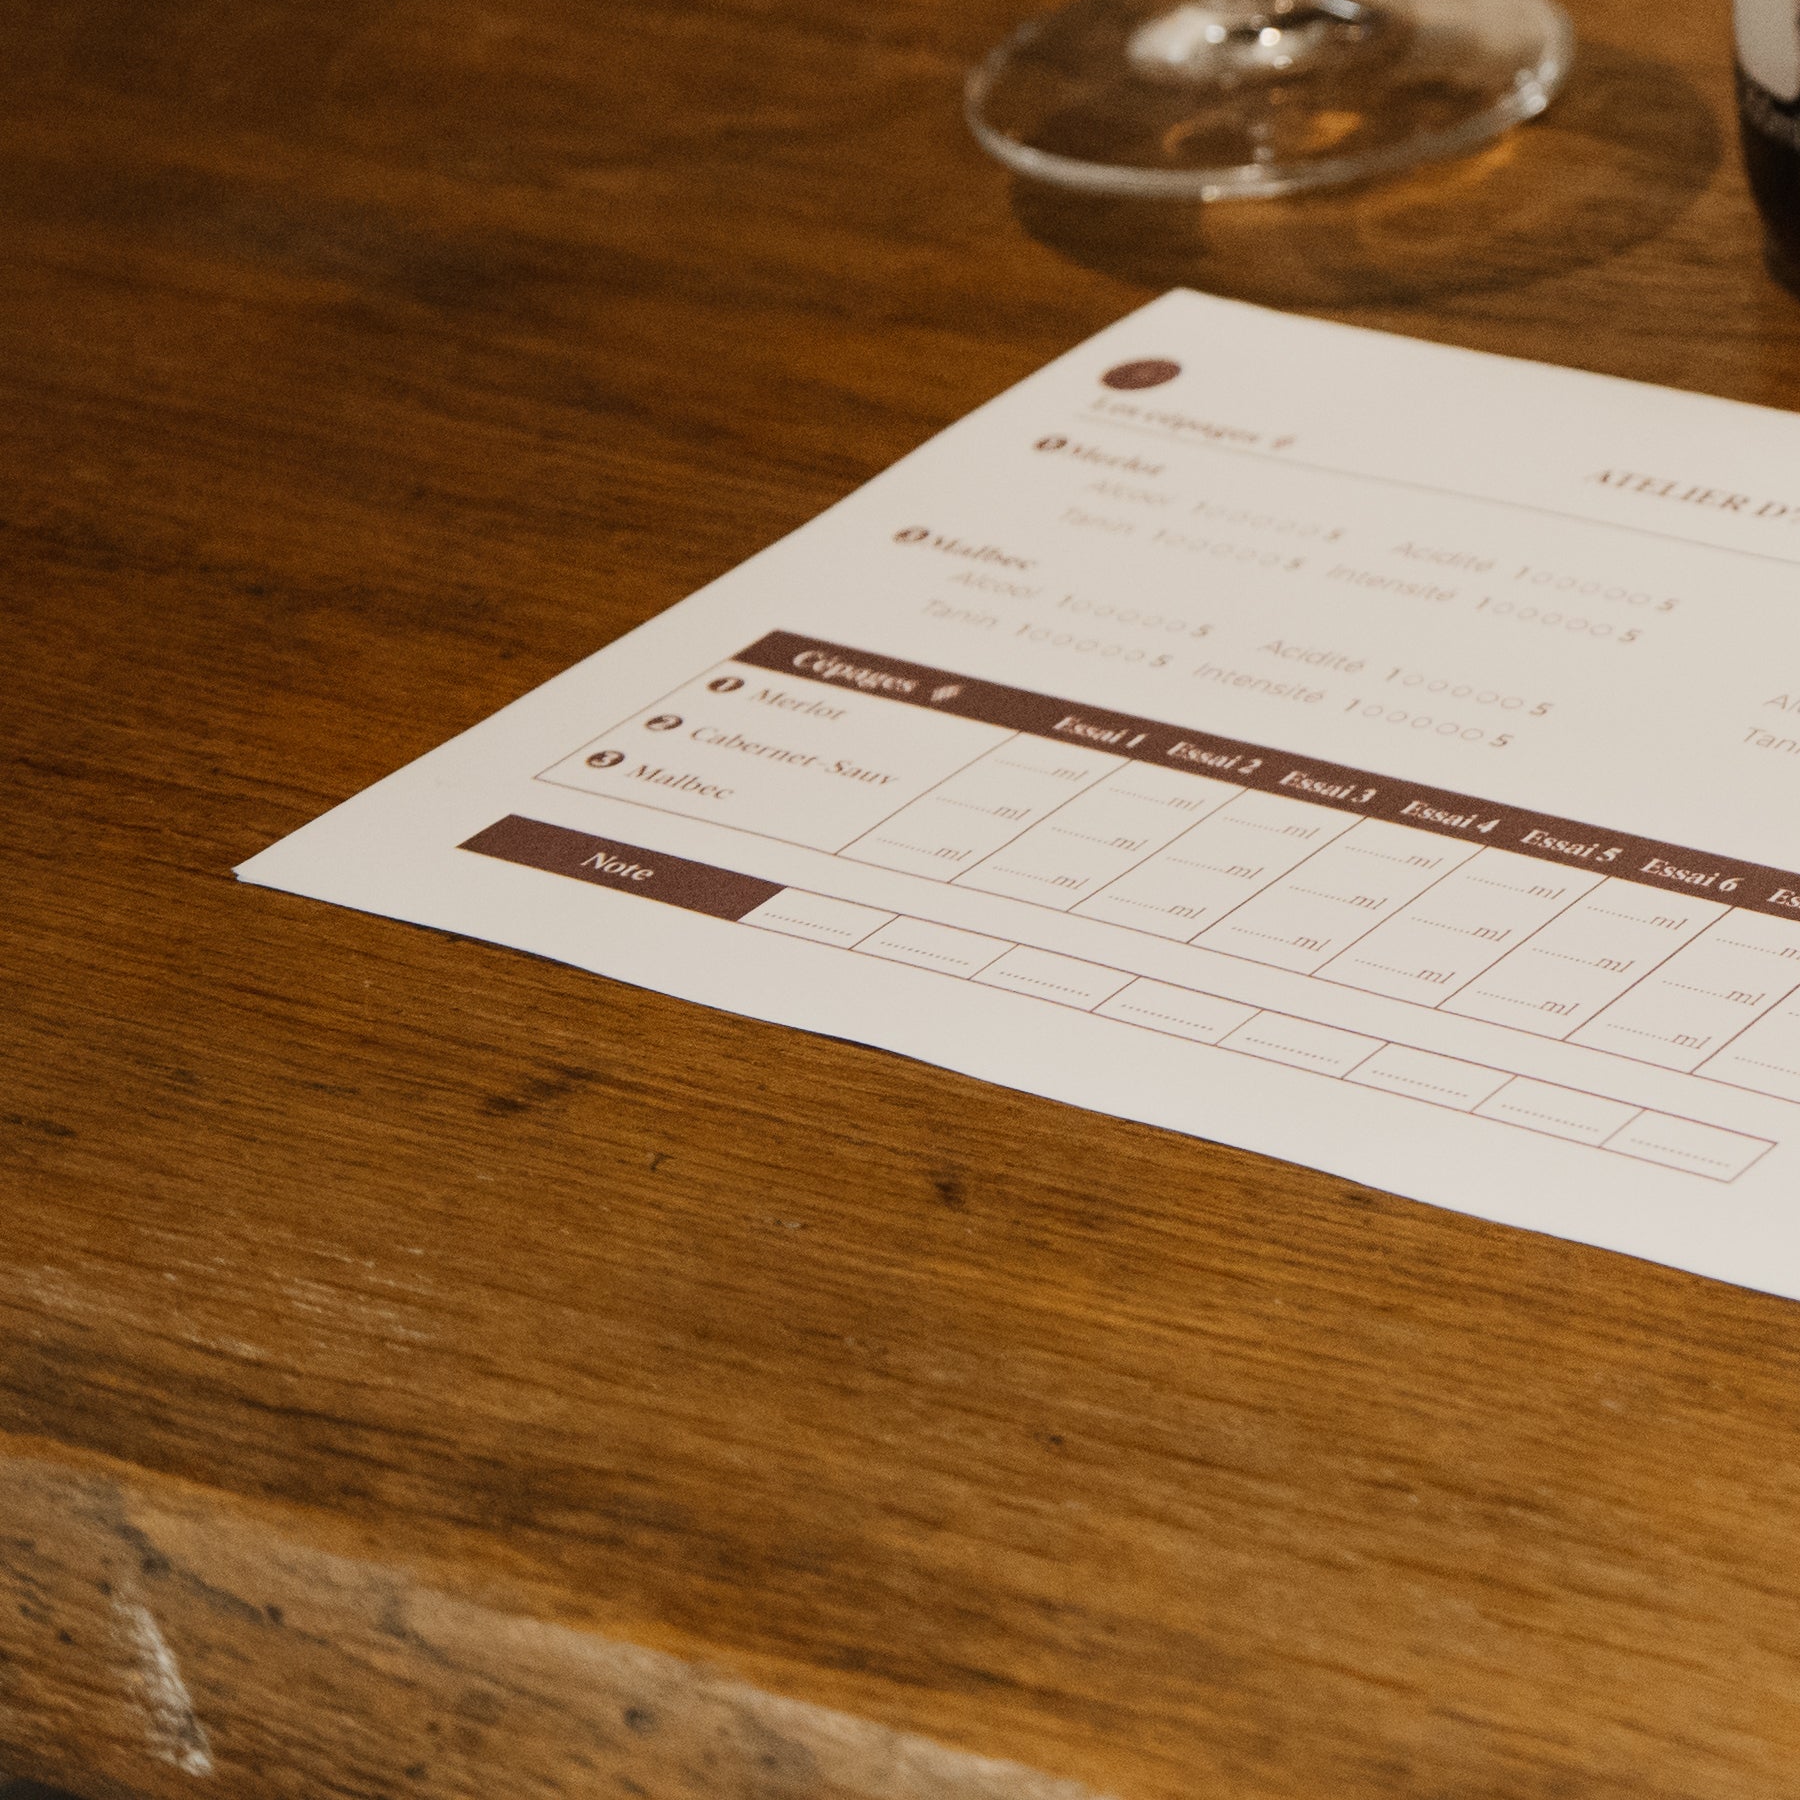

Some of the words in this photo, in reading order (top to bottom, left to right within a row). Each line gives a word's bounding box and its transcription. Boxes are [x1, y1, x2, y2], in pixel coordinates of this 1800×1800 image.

[1585, 467, 1752, 514] ATELIER
[792, 650, 919, 693] Cépages
[750, 687, 848, 721] Merlot
[1053, 716, 1127, 745] Essai
[1126, 733, 1149, 749] 1
[690, 725, 898, 788] Cabernet-Sauv
[1167, 741, 1240, 771] Essai
[1238, 758, 1263, 775] 2
[625, 763, 735, 800] Malbec
[1278, 770, 1353, 800] Essai
[1352, 788, 1378, 805] 3
[1399, 800, 1477, 831] Essai
[1476, 818, 1501, 834] 4
[1519, 828, 1599, 861] Essai
[1596, 847, 1624, 864] 5
[580, 851, 655, 882] Note
[1640, 858, 1718, 889] Essai
[1718, 876, 1745, 893] 6
